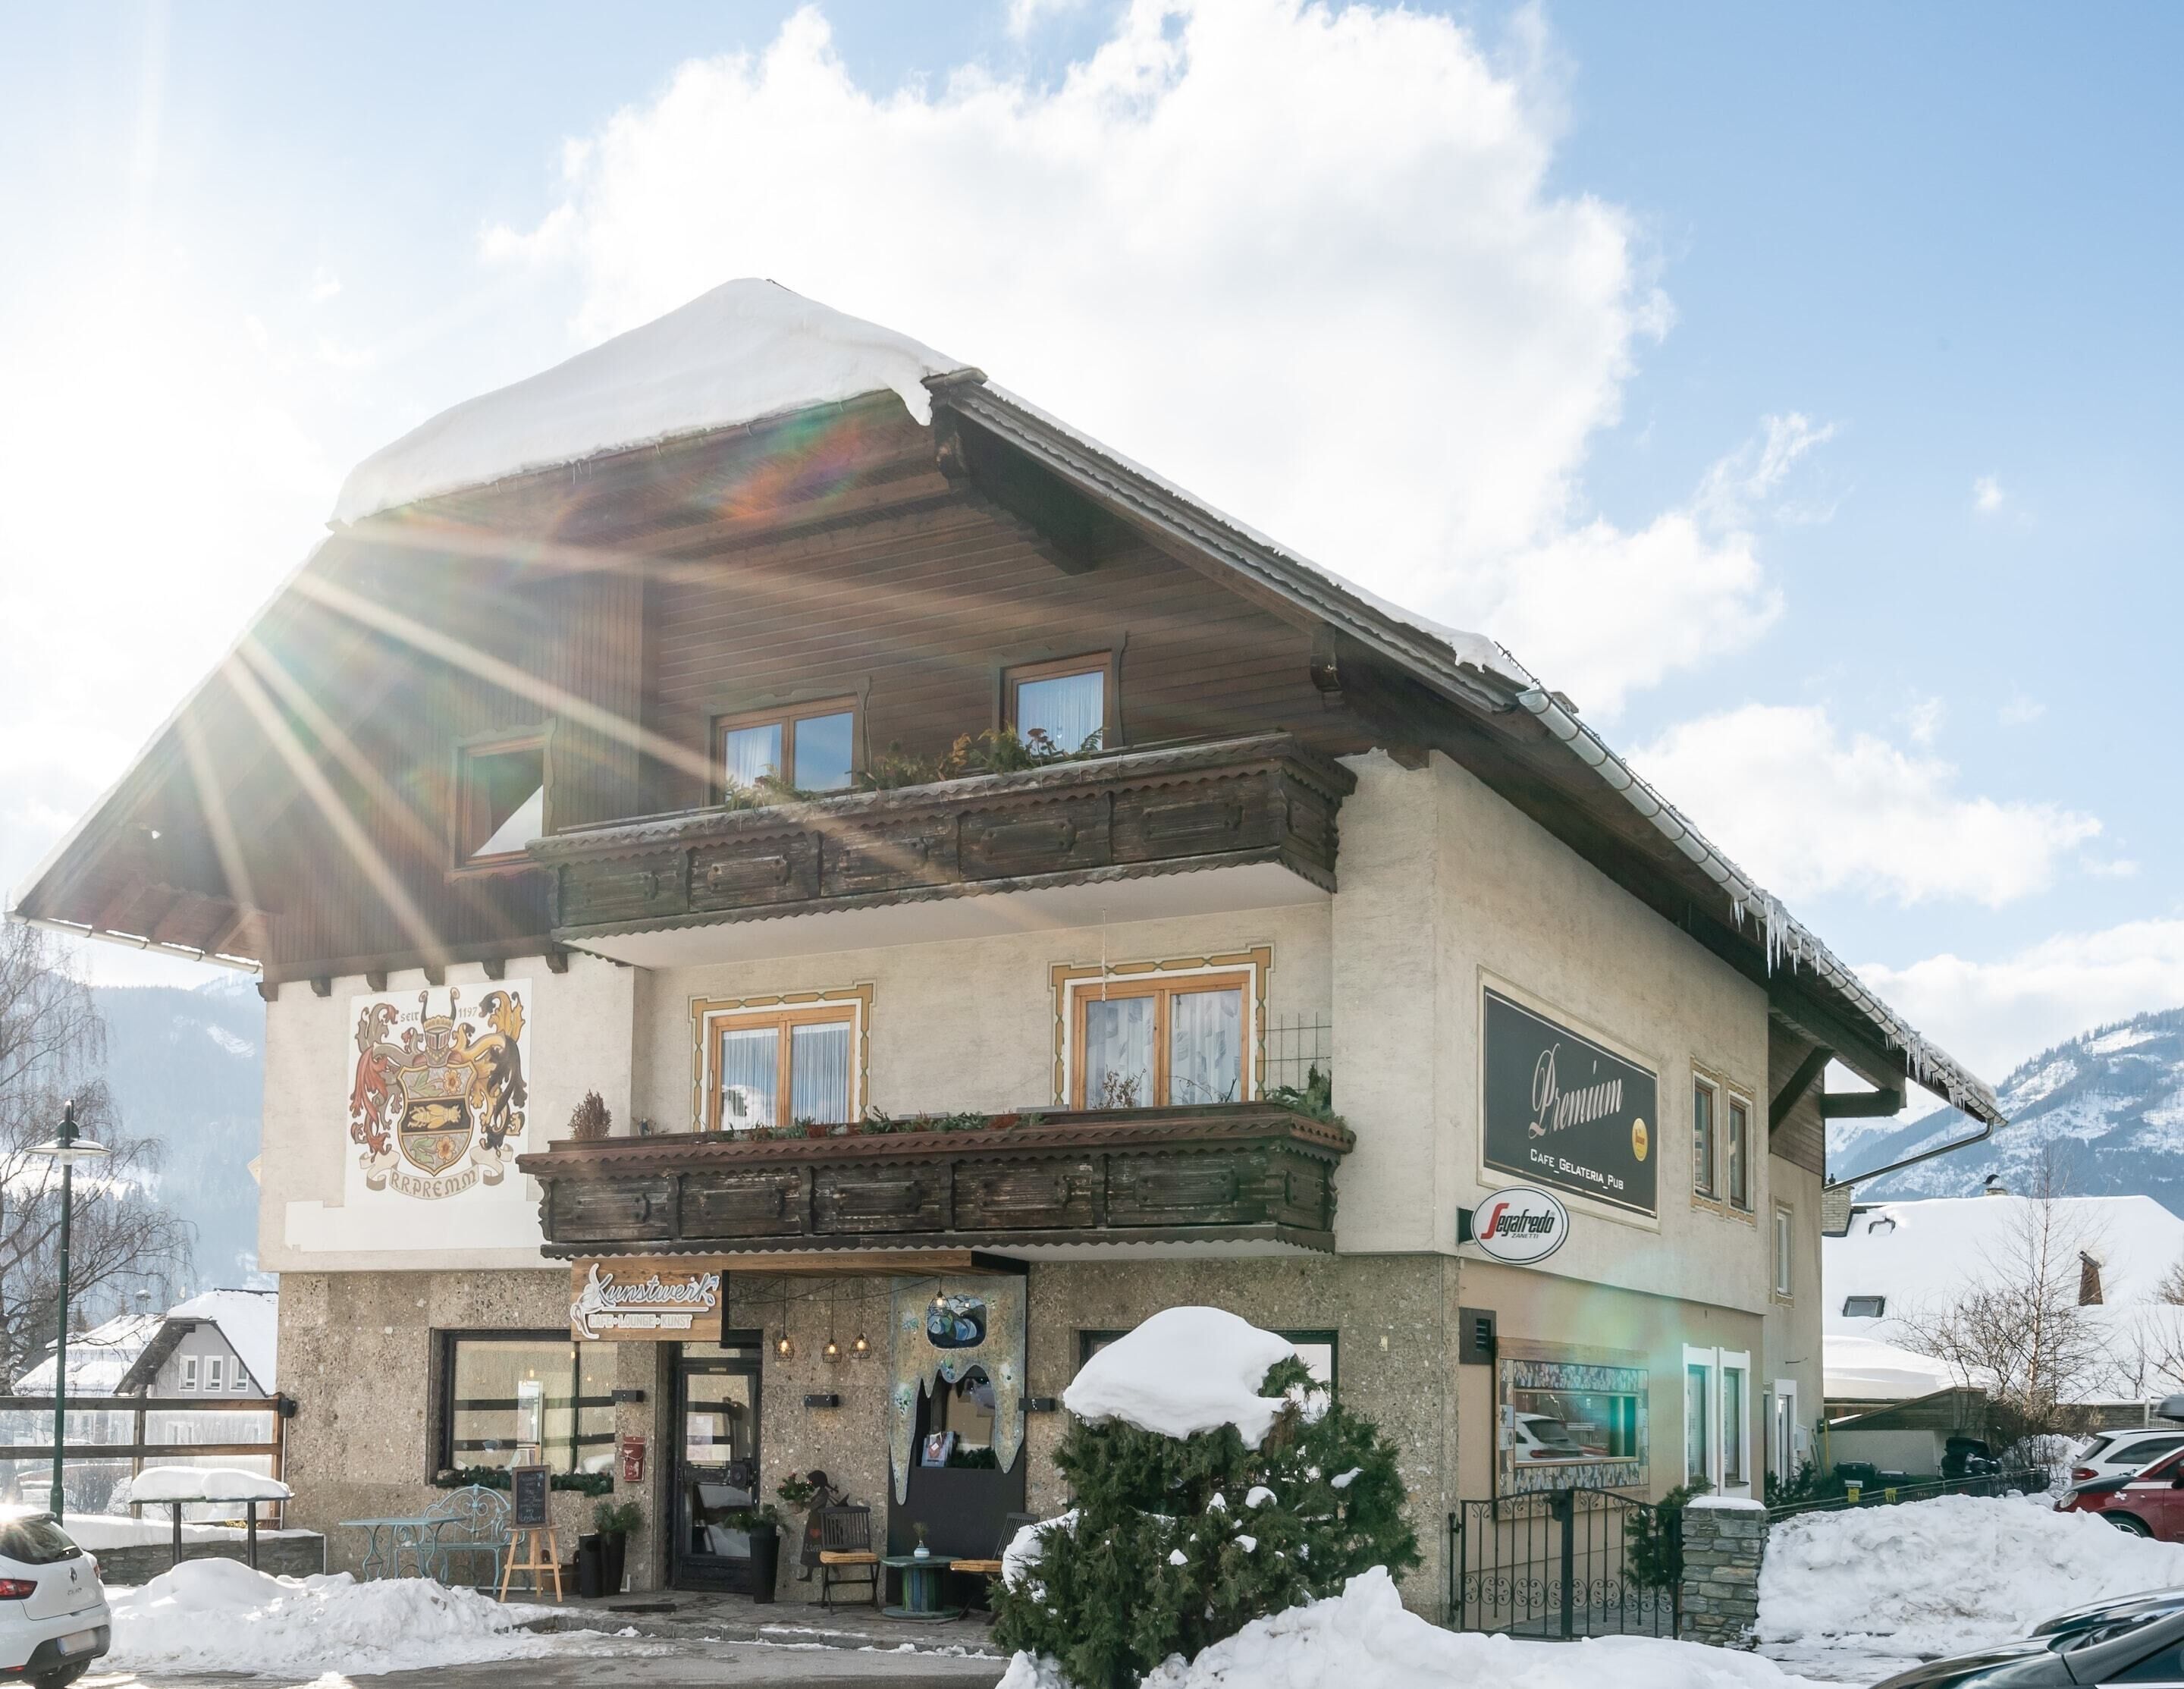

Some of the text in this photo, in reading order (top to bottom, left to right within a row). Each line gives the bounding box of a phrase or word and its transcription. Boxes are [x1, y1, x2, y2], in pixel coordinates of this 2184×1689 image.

[458, 1006, 478, 1019] 1197
[1528, 1043, 1623, 1139] Premium
[1480, 1202, 1555, 1239] Segafredo
[598, 1273, 717, 1306] Kunstwerk
[618, 1314, 656, 1328] LOUNGE
[661, 1314, 692, 1329] KUNST
